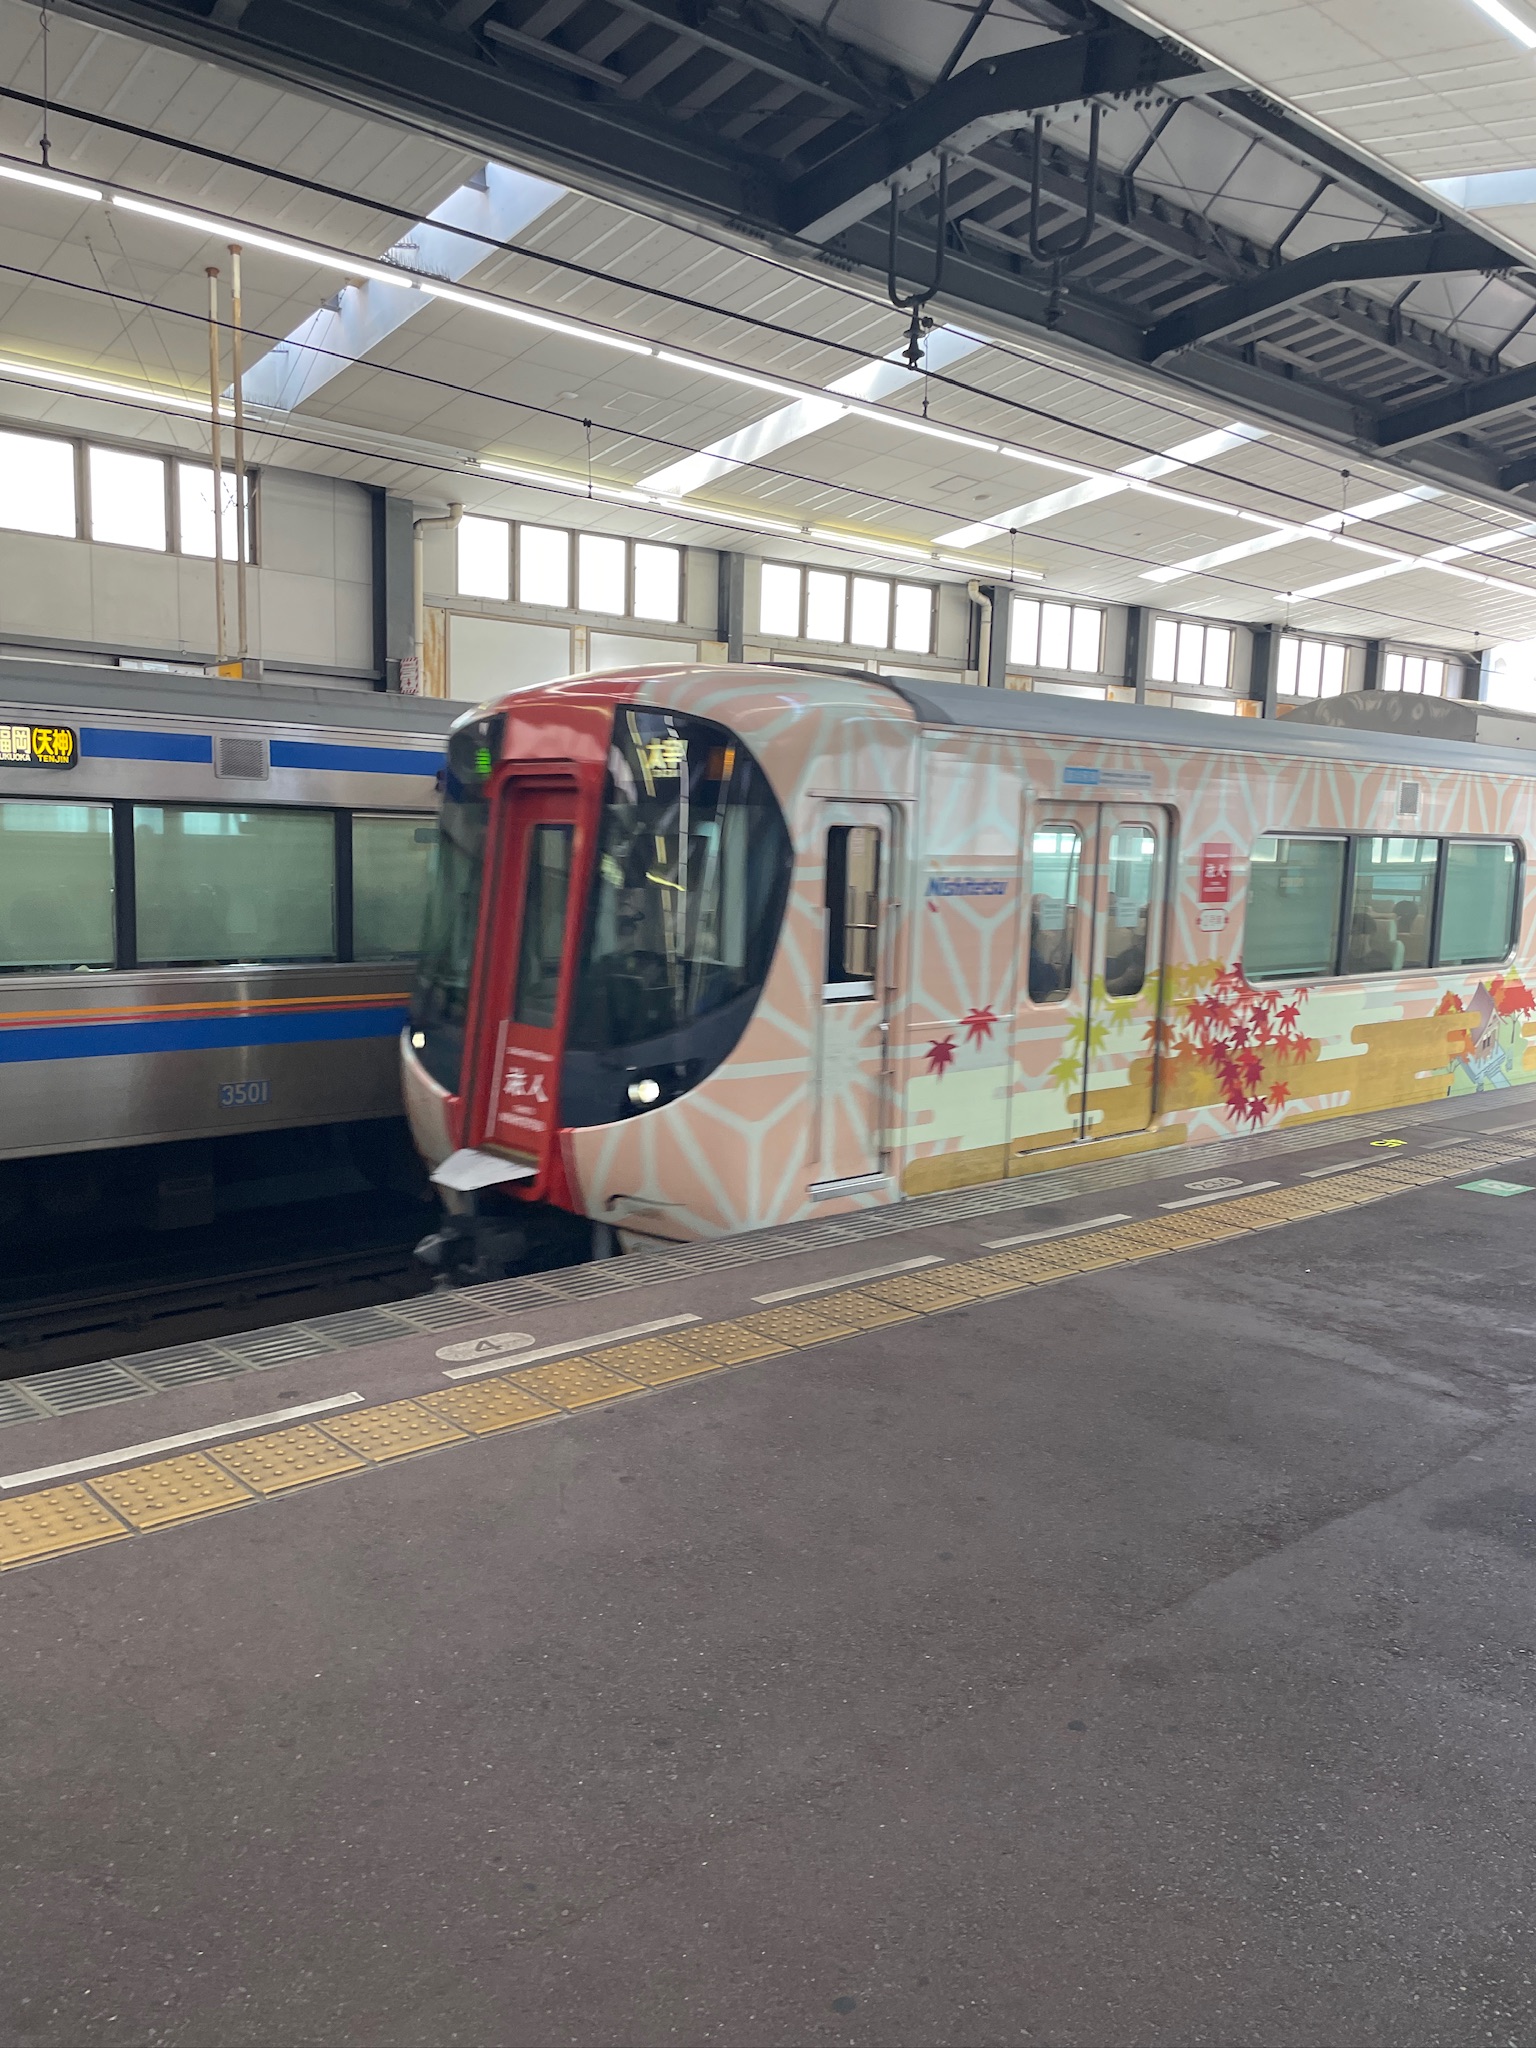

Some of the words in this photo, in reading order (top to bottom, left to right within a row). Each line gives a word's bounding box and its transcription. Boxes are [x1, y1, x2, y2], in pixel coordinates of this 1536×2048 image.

[37, 755, 70, 763] TENJIN
[221, 1082, 268, 1106] 3501
[475, 1340, 502, 1352] 4
